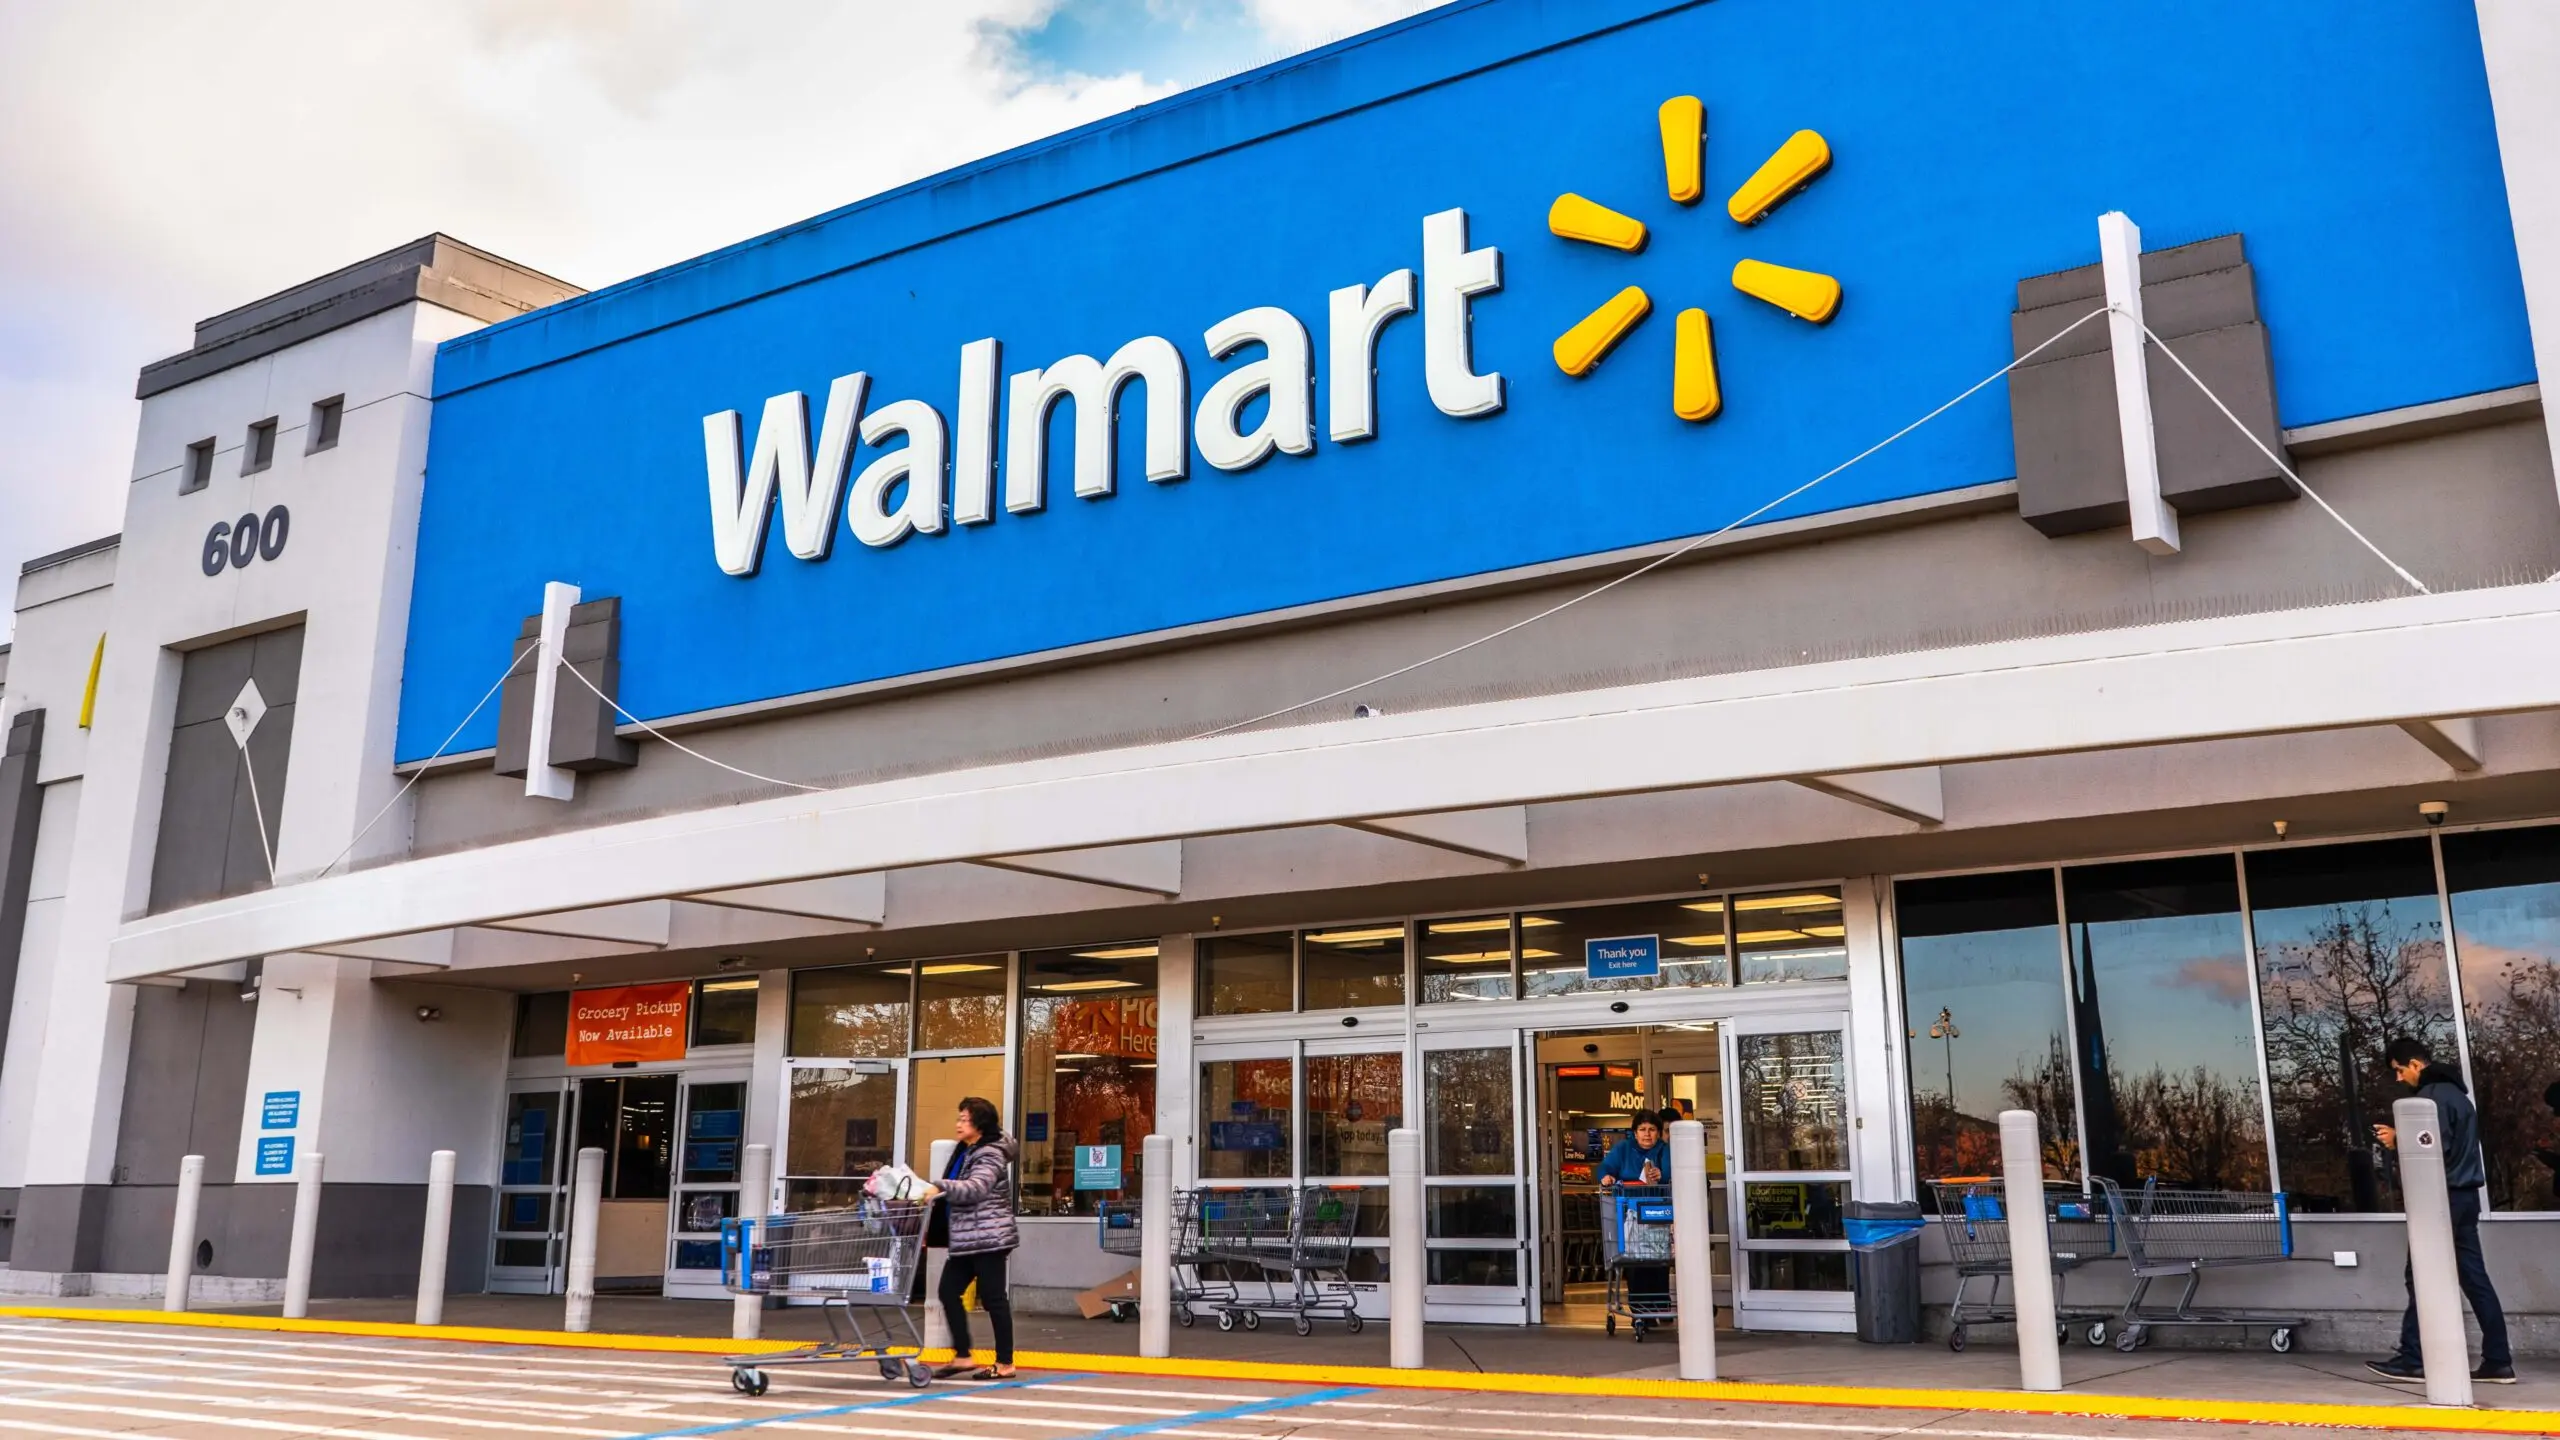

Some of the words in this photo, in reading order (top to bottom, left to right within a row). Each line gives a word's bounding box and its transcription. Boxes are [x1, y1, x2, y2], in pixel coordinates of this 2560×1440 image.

[703, 208, 1504, 577] Walmart
[202, 504, 290, 577] 600
[1597, 947, 1627, 959] Thank
[1629, 948, 1647, 960] you
[577, 1005, 630, 1021] Grocery
[636, 1001, 682, 1017] Pickup
[579, 1029, 601, 1043] Now
[606, 1024, 673, 1041] Available
[1121, 1026, 1158, 1053] Here
[1645, 1208, 1665, 1216] Walmart
